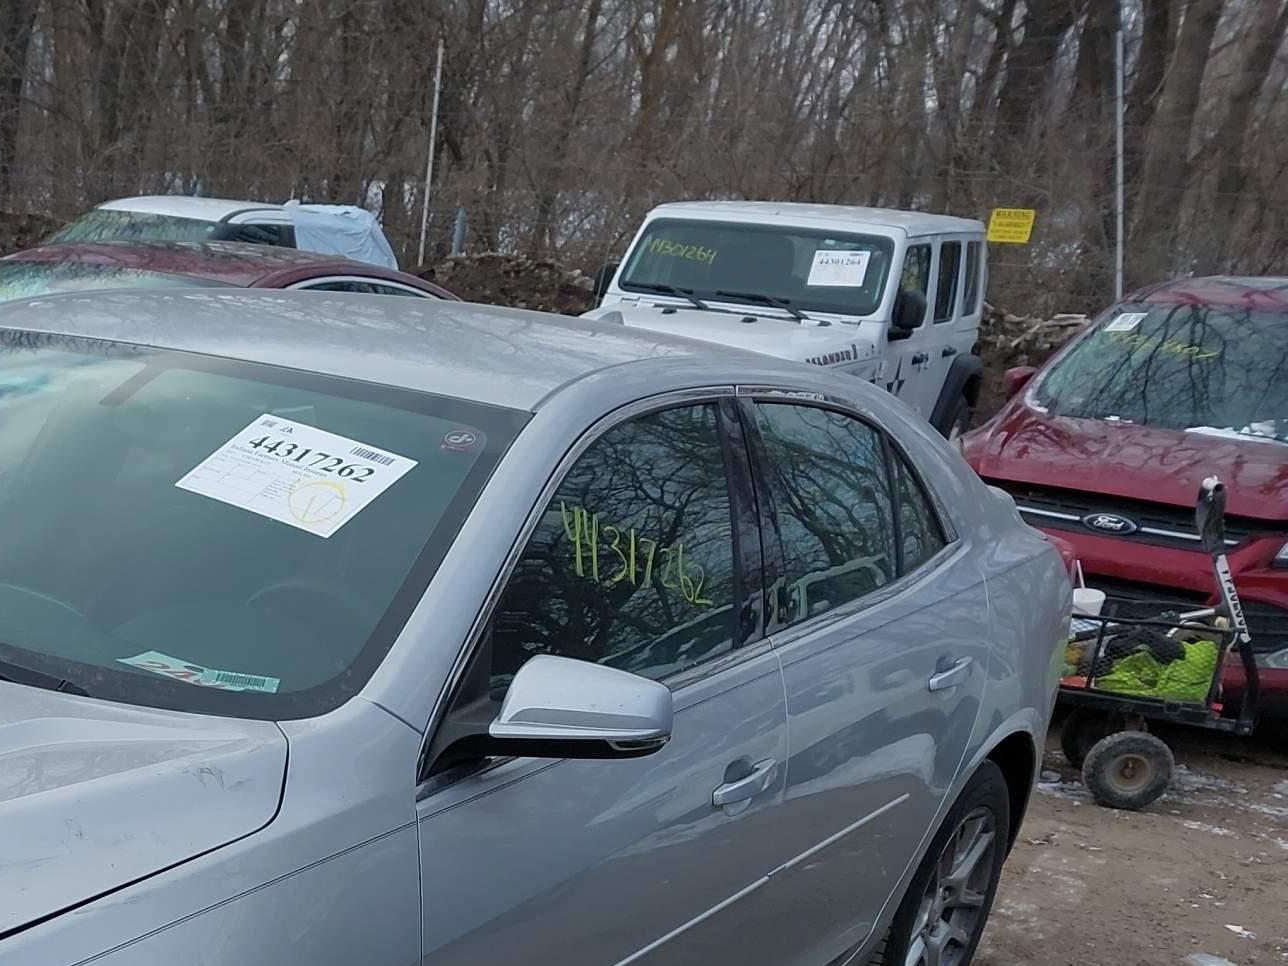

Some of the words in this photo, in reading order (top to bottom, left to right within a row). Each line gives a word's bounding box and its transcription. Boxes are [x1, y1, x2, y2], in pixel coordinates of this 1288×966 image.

[248, 435, 376, 484] 44317262
[1093, 515, 1125, 531] Ford
[561, 500, 713, 606] 44317262
